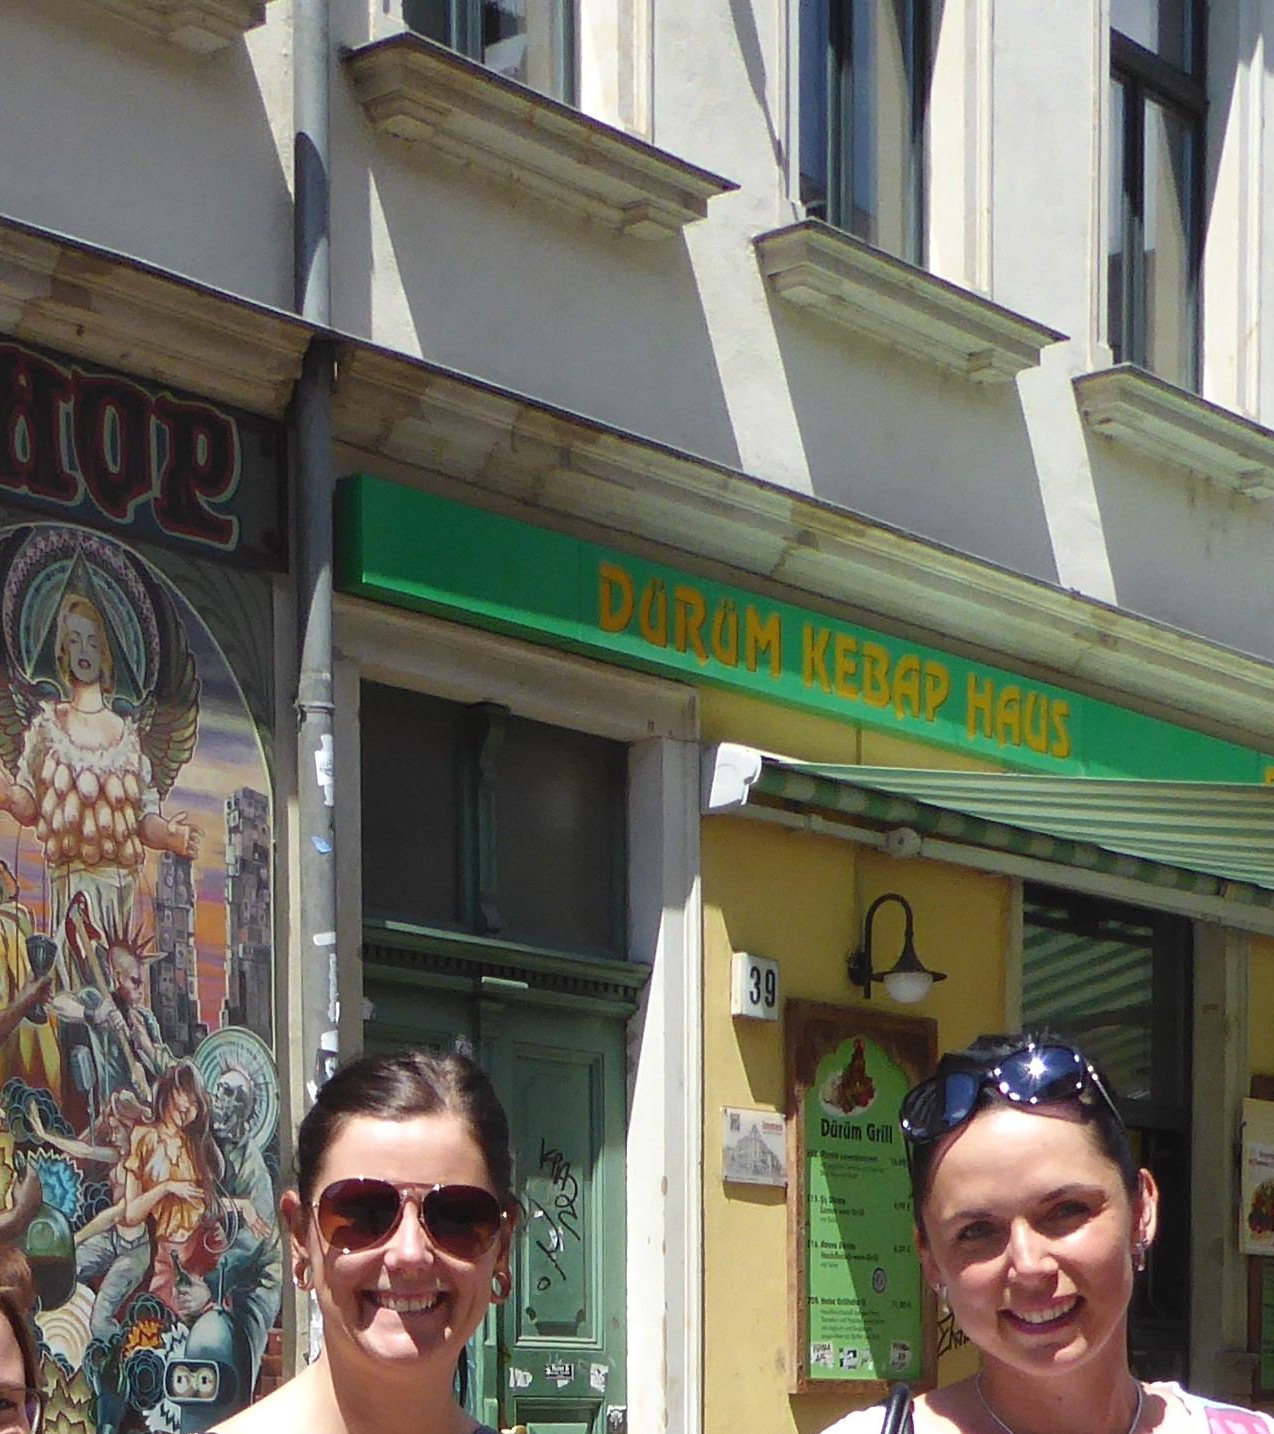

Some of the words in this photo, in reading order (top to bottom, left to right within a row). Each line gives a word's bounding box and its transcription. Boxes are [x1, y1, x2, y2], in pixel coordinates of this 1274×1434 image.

[599, 562, 782, 679] DÜRÜM
[802, 622, 951, 723] KEBAP
[966, 671, 1071, 760] HAUS
[748, 965, 777, 1009] 39
[820, 1118, 863, 1141] Dürüm
[866, 1123, 893, 1145] Grill
